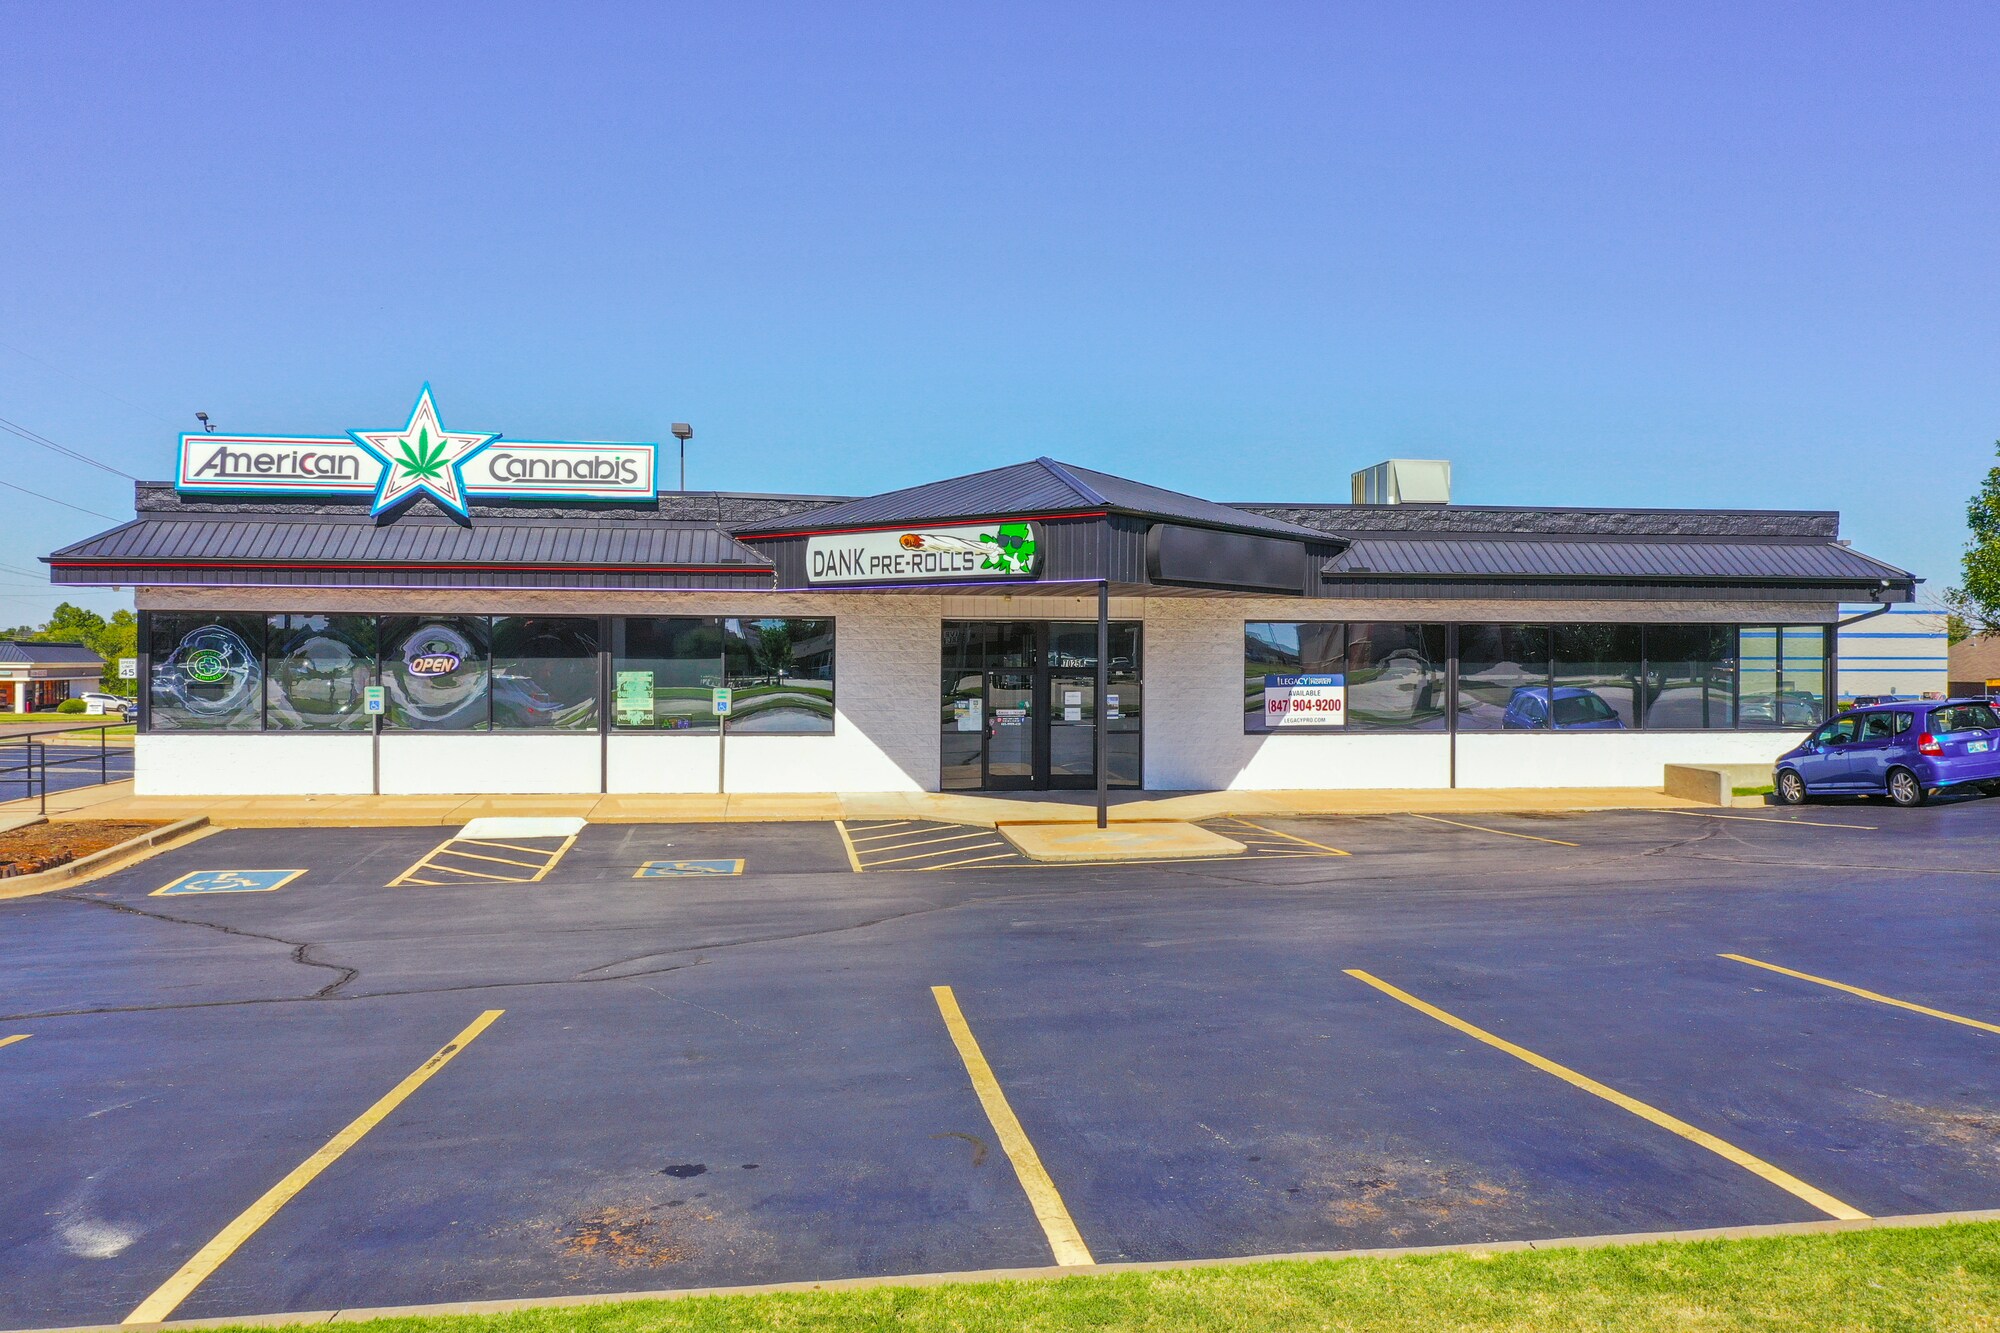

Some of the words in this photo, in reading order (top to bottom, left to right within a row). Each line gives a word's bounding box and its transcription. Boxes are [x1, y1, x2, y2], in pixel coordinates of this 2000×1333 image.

[194, 446, 360, 480] American
[489, 453, 640, 485] Cannabis
[813, 547, 866, 577] DANK
[870, 551, 975, 575] PRE-ROLLS
[412, 658, 455, 673] OPEN
[121, 669, 135, 677] 45
[1280, 677, 1309, 685] LEGACY
[1268, 699, 1290, 713] (847)
[1292, 699, 1341, 711] 904-9200
